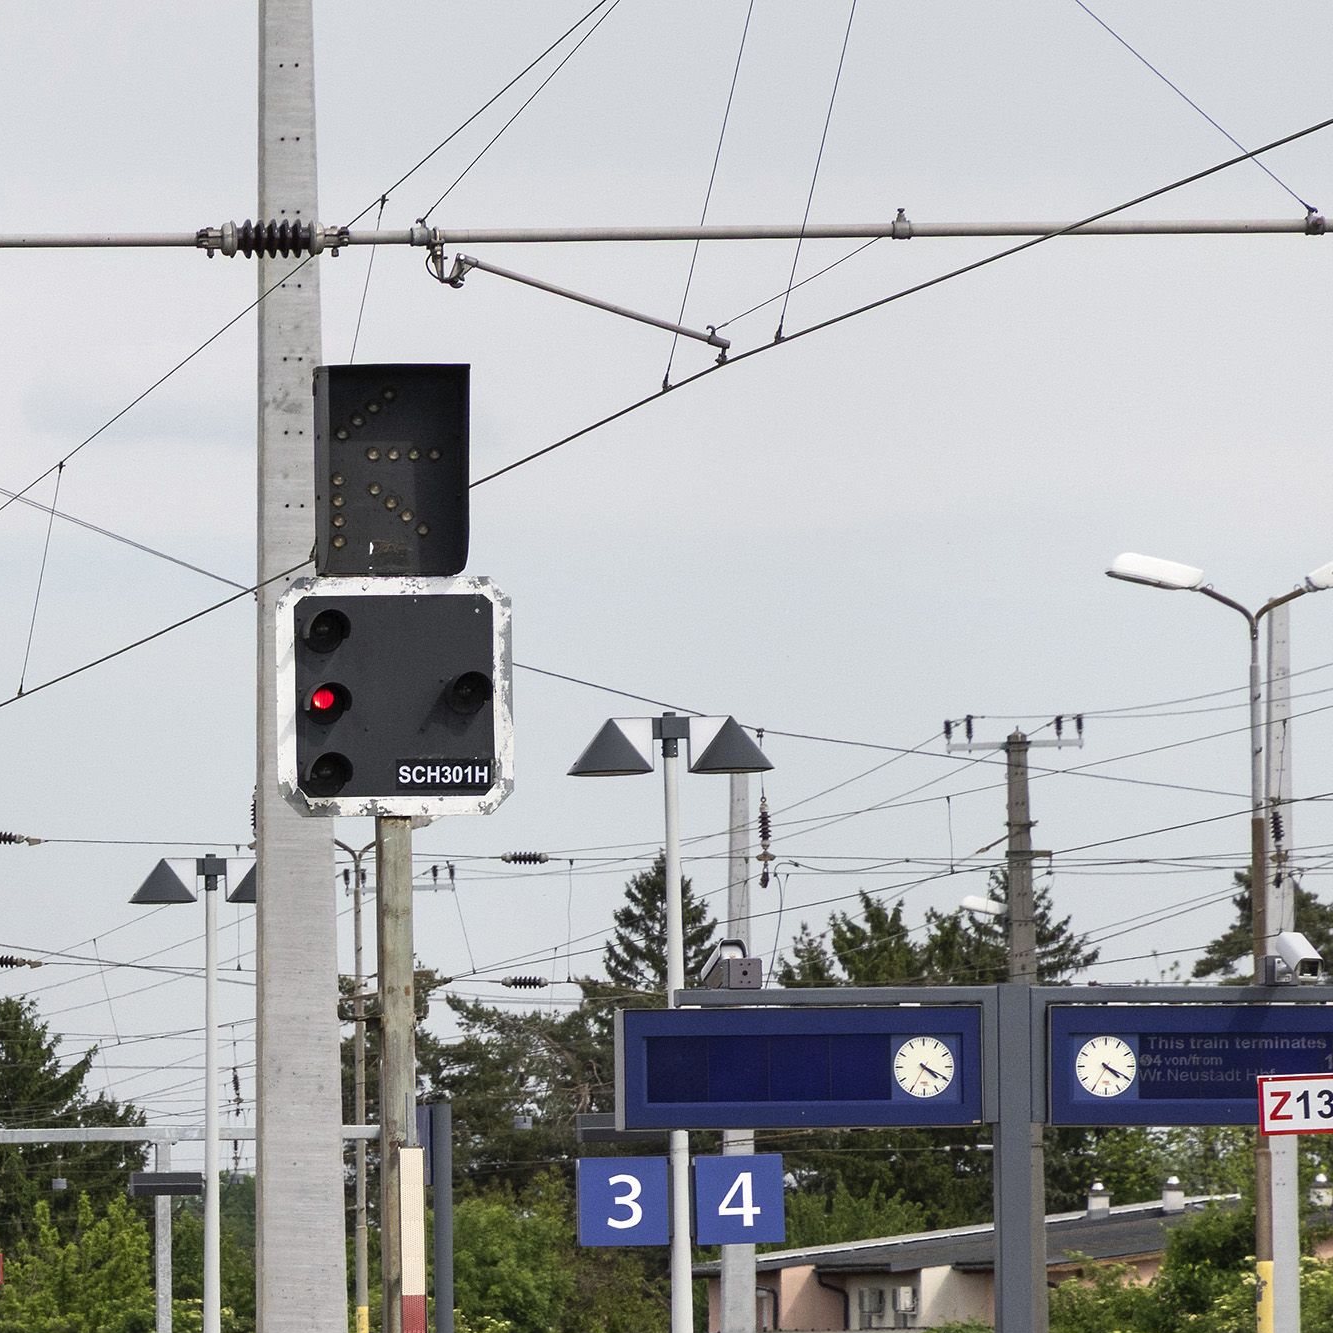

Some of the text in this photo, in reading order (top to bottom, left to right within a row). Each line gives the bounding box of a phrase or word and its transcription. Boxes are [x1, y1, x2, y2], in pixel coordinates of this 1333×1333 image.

[397, 764, 489, 784] SCH301H
[1147, 1036, 1327, 1049] This train terminates
[606, 1171, 761, 1230] 3 4
